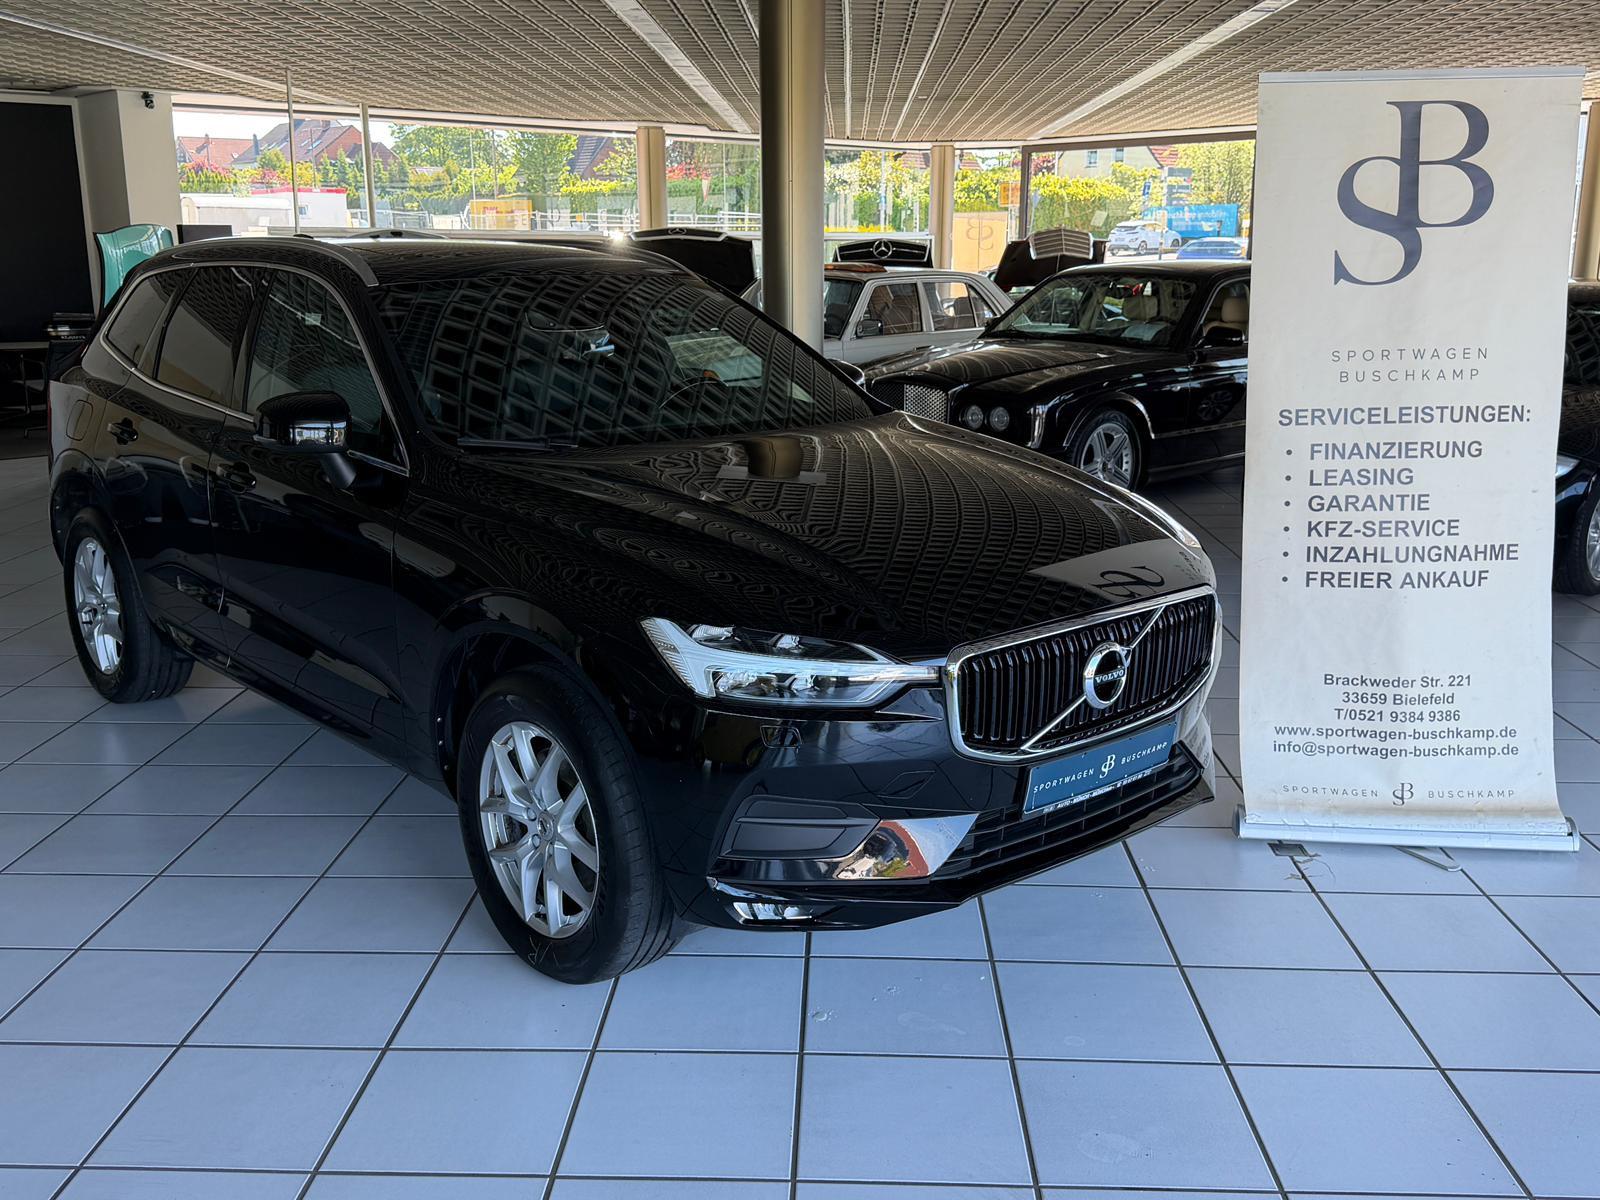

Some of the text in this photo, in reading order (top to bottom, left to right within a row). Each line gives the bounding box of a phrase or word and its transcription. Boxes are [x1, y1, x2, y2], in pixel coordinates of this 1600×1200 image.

[1331, 347, 1488, 363] SPORTWAGEN
[1339, 368, 1480, 383] BUSCHKAMP
[1278, 405, 1531, 427] SERVICELEISTUNGEN:
[1309, 440, 1483, 461] FINANZIERUNG
[1309, 467, 1414, 487] LEASING
[1308, 493, 1431, 512] GARANTIE
[1307, 519, 1460, 538] KFZ-SERVICE
[1306, 543, 1519, 563] INZAHLUNGNAHME
[1305, 569, 1490, 589] FREIER ANKAUF
[1095, 669, 1125, 684] VOLVO
[1323, 673, 1472, 689] Brackweder Str. 221
[1342, 691, 1455, 706] 33659 Bielefeld
[1334, 708, 1461, 724] T/0521 9384 9386
[1274, 724, 1518, 743] www.sportwagen-buschkamp.de
[1273, 740, 1519, 760] info@sportwagen-buschkamp.de
[1033, 768, 1095, 794] SPORTWAGEN
[1121, 741, 1168, 765] BUSCHKAMP
[1282, 784, 1379, 798] SPORTWAGEN
[1428, 789, 1515, 799] BUSCHKAMP
